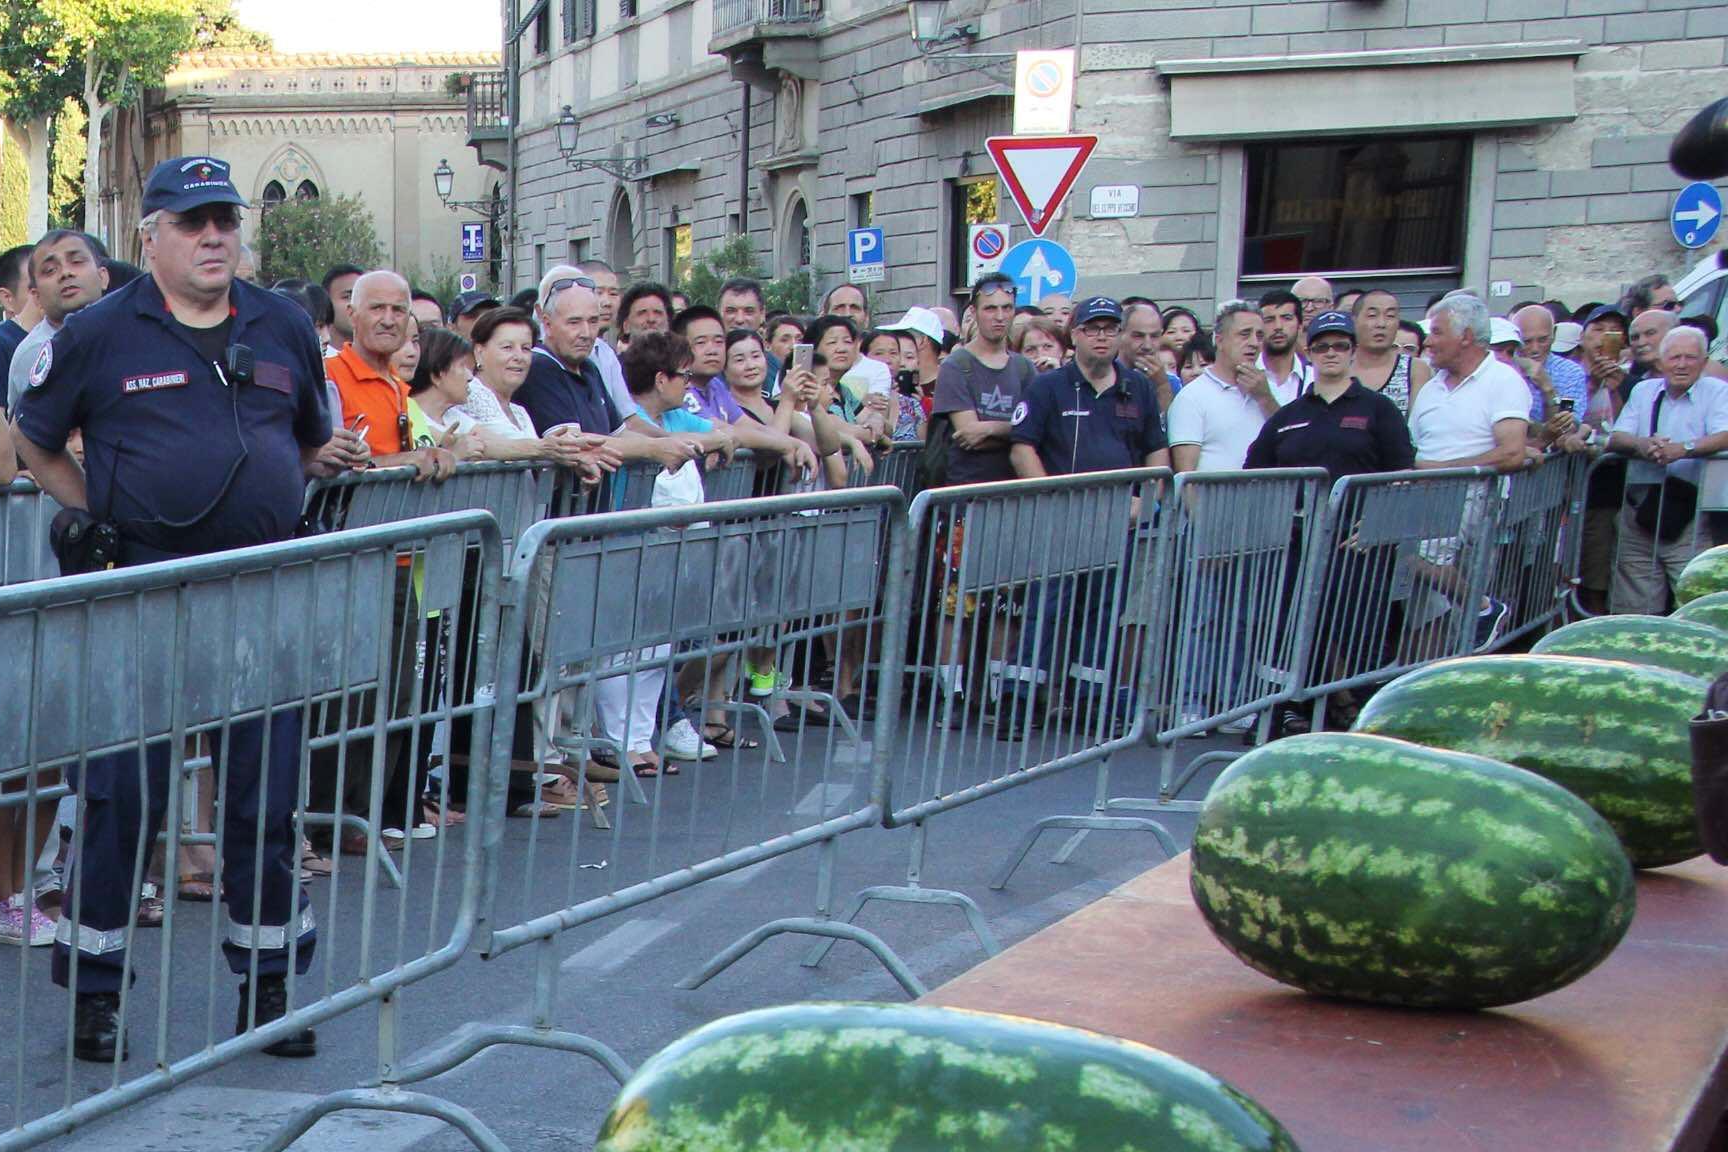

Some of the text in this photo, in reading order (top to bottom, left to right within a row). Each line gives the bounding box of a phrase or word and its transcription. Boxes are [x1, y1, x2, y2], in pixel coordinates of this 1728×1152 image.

[1108, 189, 1122, 199] VIA
[464, 225, 481, 252] T
[854, 232, 877, 262] P
[683, 392, 702, 413] 3
